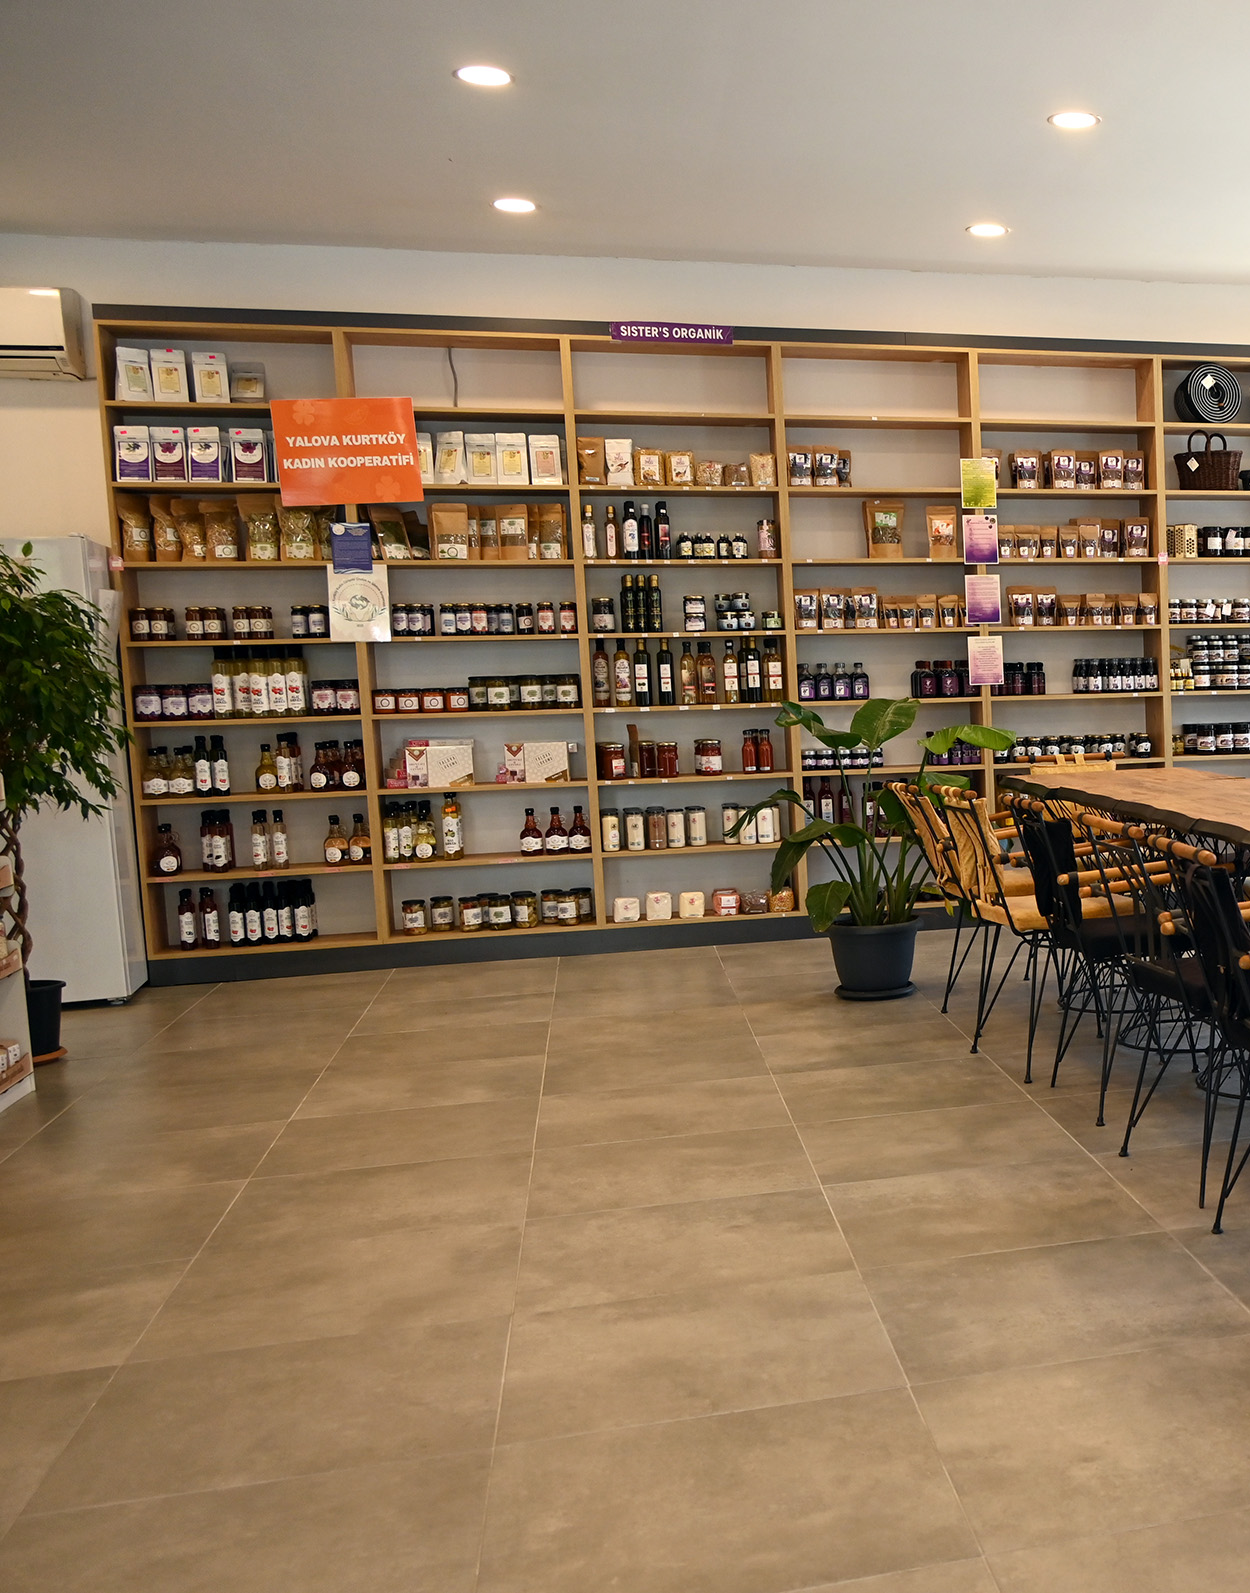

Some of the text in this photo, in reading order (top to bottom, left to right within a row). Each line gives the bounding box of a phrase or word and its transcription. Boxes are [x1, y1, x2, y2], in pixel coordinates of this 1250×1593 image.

[620, 325, 724, 340] SISTER'S ORGANİK
[285, 431, 406, 448] YALOVA KURTKÖY
[283, 452, 414, 470] KADIN KOOPERATİFİ
